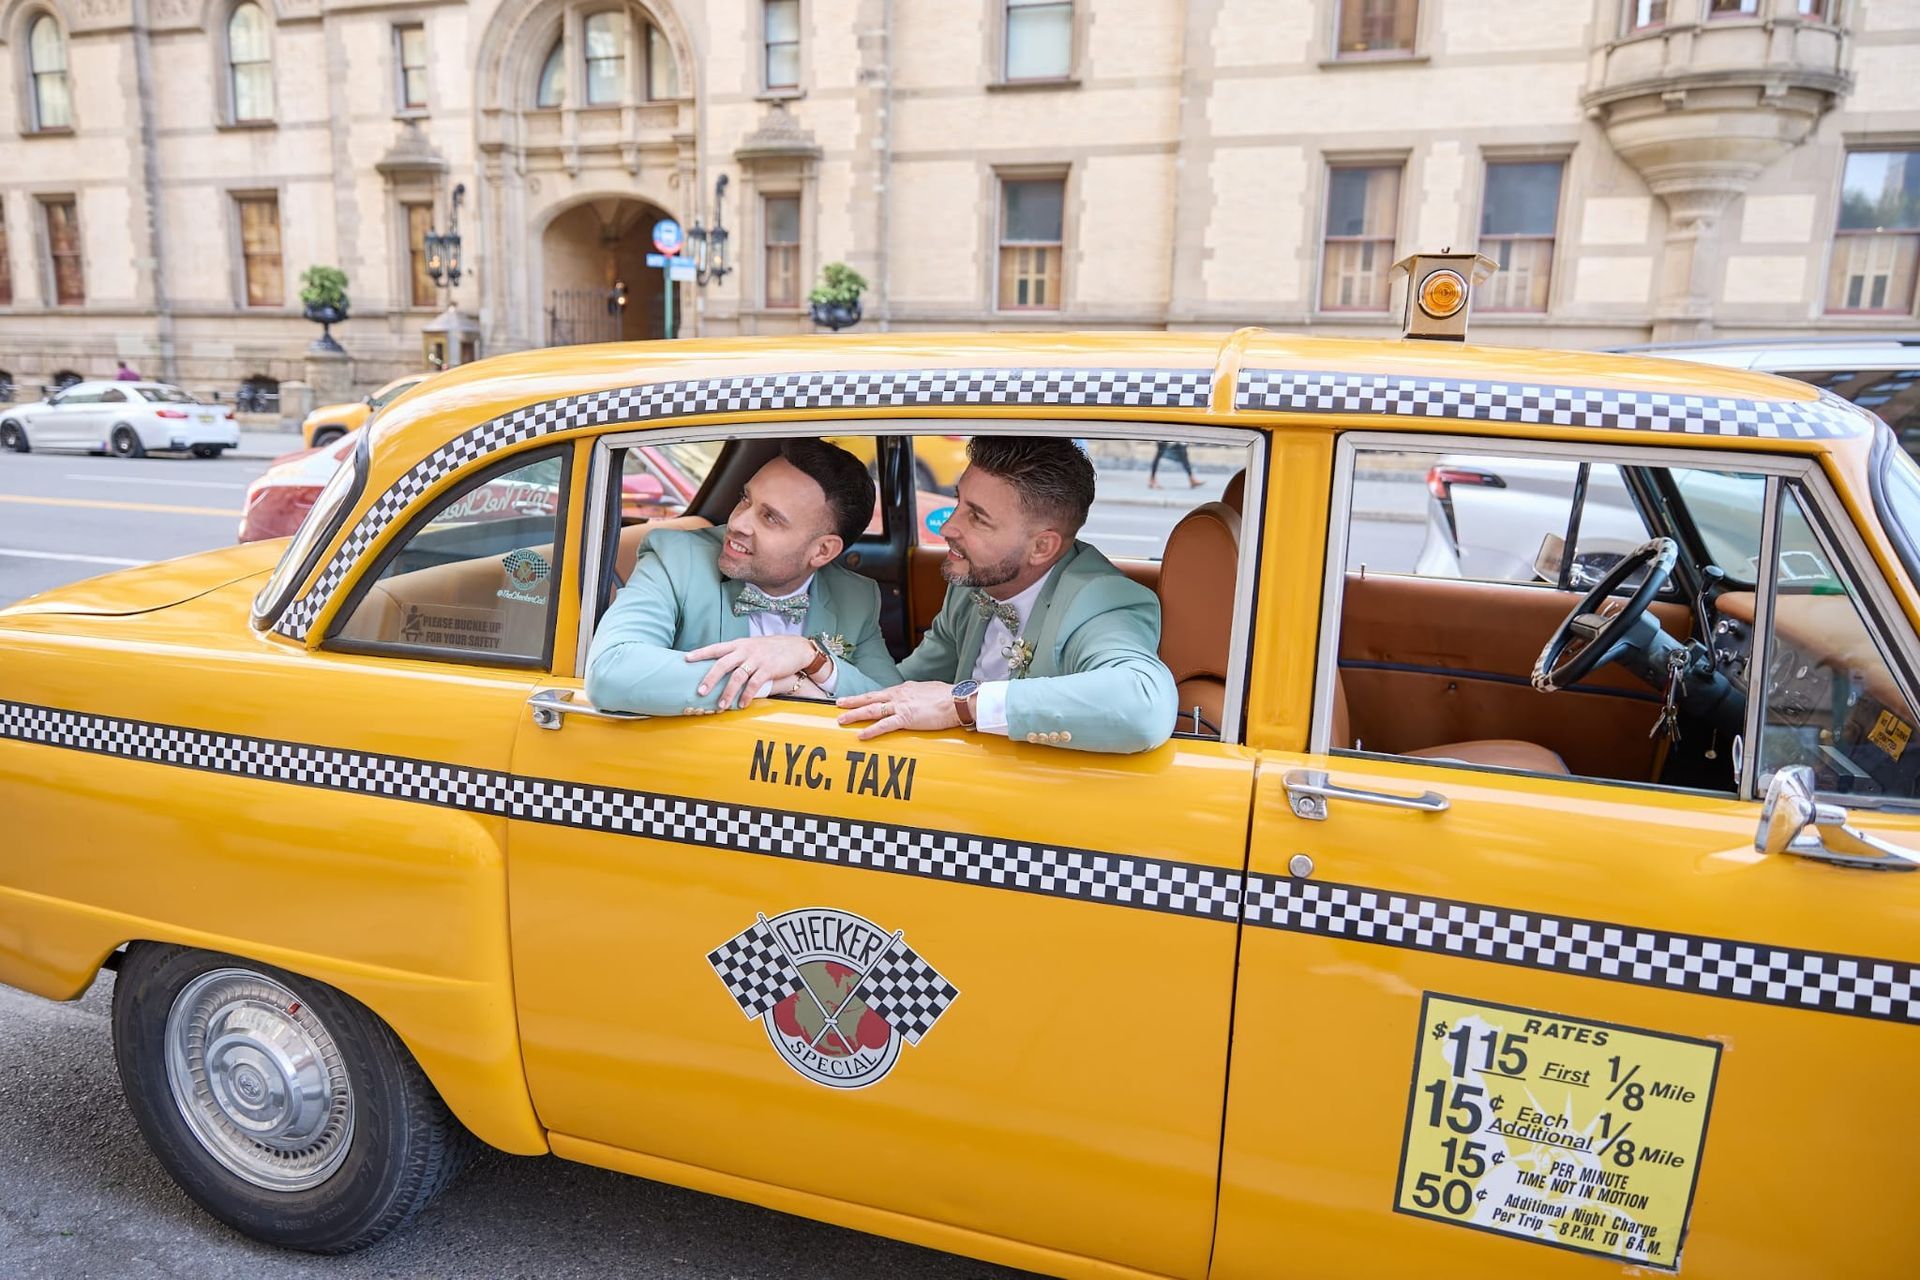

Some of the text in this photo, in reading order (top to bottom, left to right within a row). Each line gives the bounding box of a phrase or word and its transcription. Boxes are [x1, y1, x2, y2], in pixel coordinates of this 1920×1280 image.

[422, 616, 502, 633] PLEASE BUCKLE UP
[426, 632, 502, 648] FOR YOUR SAFETY
[749, 739, 917, 801] N.Y.C. TAXI
[775, 915, 884, 967] CHECKER
[1523, 1018, 1609, 1046] RATES
[790, 1040, 878, 1076] SPECIAL
[1543, 1062, 1591, 1084] First
[1649, 1081, 1696, 1104] Mile
[1488, 1117, 1593, 1151] Additional
[1516, 1106, 1569, 1130] Each
[1639, 1146, 1685, 1169] Mile
[1516, 1170, 1649, 1210] TIME NOT IN MOTION
[1549, 1161, 1575, 1179] PER
[1579, 1167, 1630, 1190] MINUTE
[1492, 1207, 1516, 1221] Per
[1517, 1212, 1543, 1231] Trip
[1559, 1222, 1568, 1236] 8
[1569, 1226, 1595, 1242] P.M.
[1602, 1230, 1619, 1247] TO
[1625, 1236, 1634, 1250] 6
[1634, 1238, 1662, 1256] A.M.
[1504, 1193, 1567, 1219] Additional
[1571, 1207, 1607, 1227] Night
[1611, 1216, 1658, 1238] Charge
